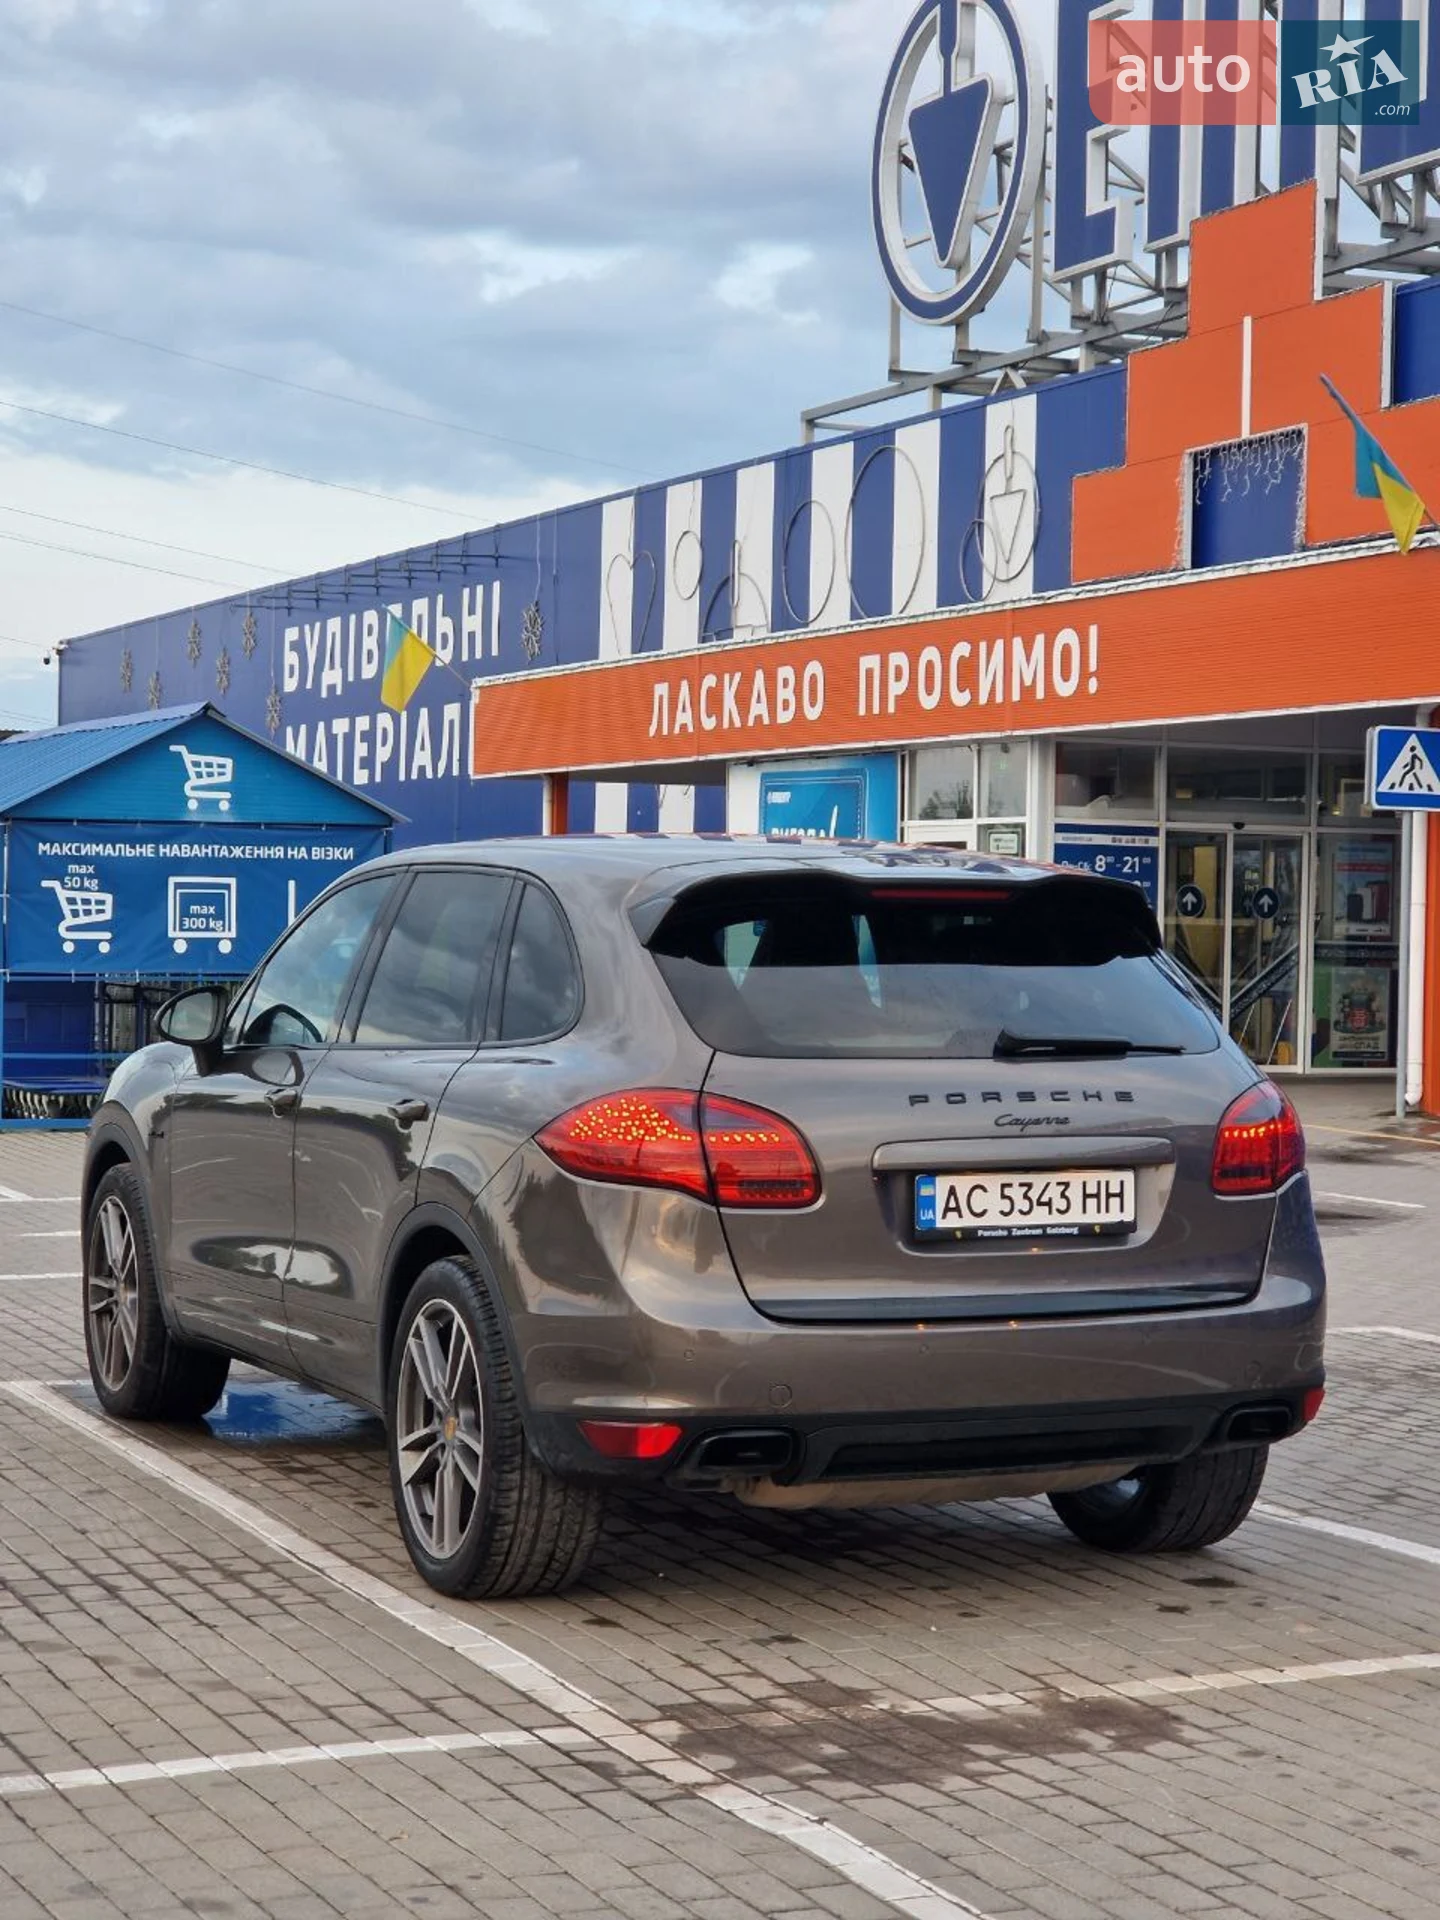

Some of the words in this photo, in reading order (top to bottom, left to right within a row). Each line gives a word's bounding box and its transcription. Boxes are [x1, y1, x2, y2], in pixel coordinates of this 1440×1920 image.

[649, 659, 824, 738] ЛАСКАВО
[858, 624, 1099, 717] ПРОСИМО!
[38, 842, 156, 858] МАКСИМАЛЬНЕ
[158, 844, 284, 859] НАВАНТАЖЕННЯ
[287, 847, 309, 860] НА
[311, 847, 355, 861] ВІЗКИ
[67, 864, 95, 874] max
[63, 876, 81, 888] 50
[83, 876, 99, 891] kg
[189, 904, 216, 915] max
[182, 917, 206, 930] 300
[209, 917, 224, 932] kg
[908, 1090, 1135, 1107] PORSCHE
[994, 1113, 1071, 1131] Cayenne
[941, 1184, 989, 1220] AC
[999, 1181, 1072, 1217] 5343
[1082, 1179, 1124, 1214] HH
[920, 1209, 935, 1220] UA
